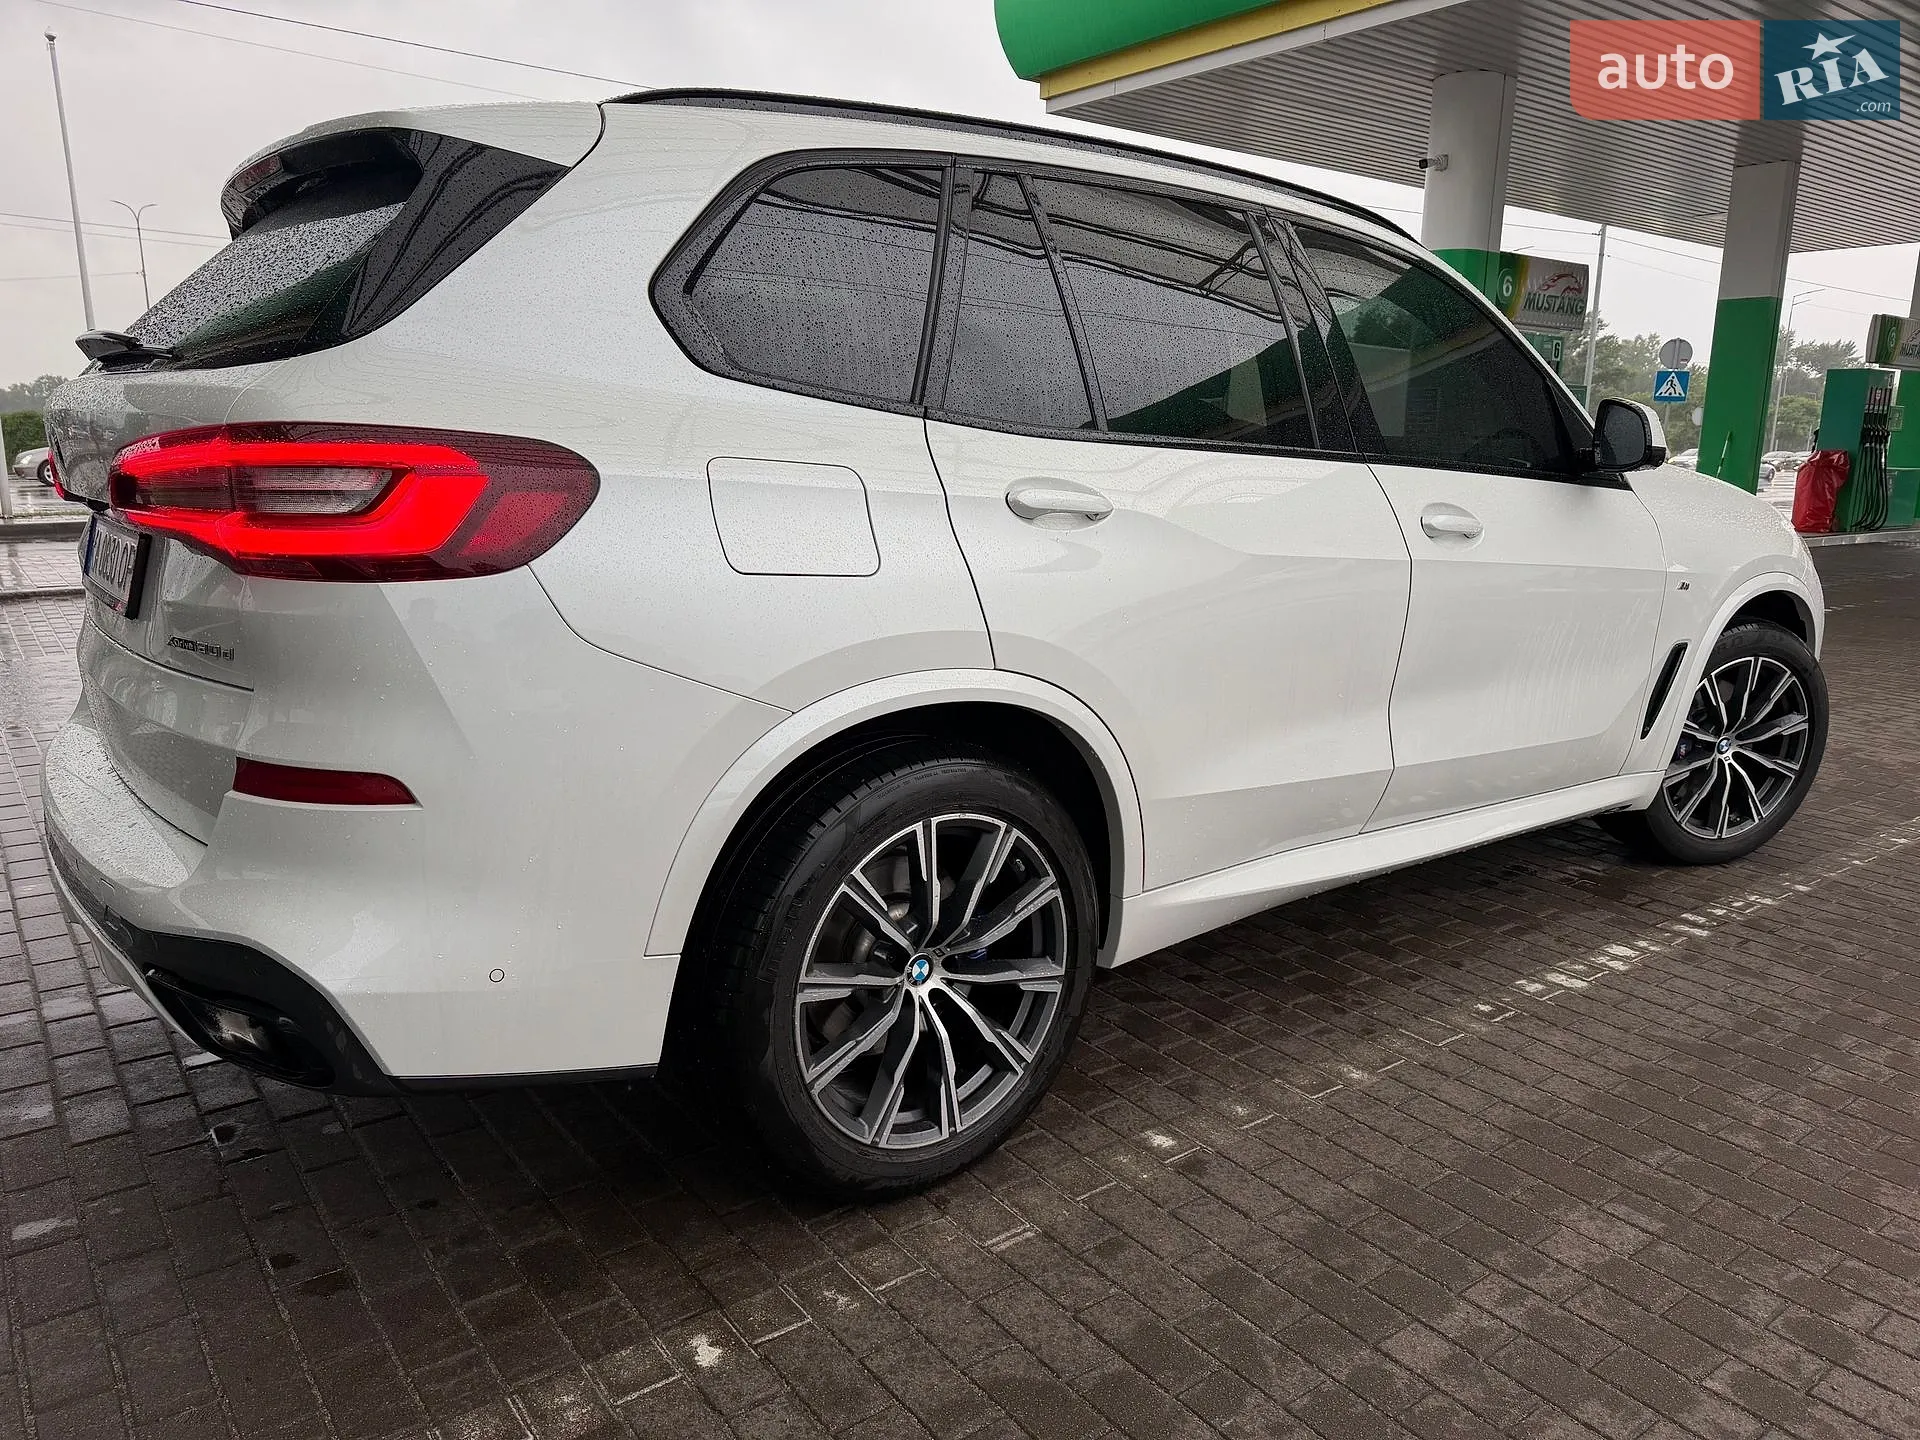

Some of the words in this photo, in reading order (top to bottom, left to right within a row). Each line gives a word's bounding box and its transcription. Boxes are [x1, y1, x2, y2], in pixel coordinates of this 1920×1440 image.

[1502, 275, 1513, 297] 6
[1523, 291, 1585, 316] MUSTANG
[1553, 342, 1561, 359] 6
